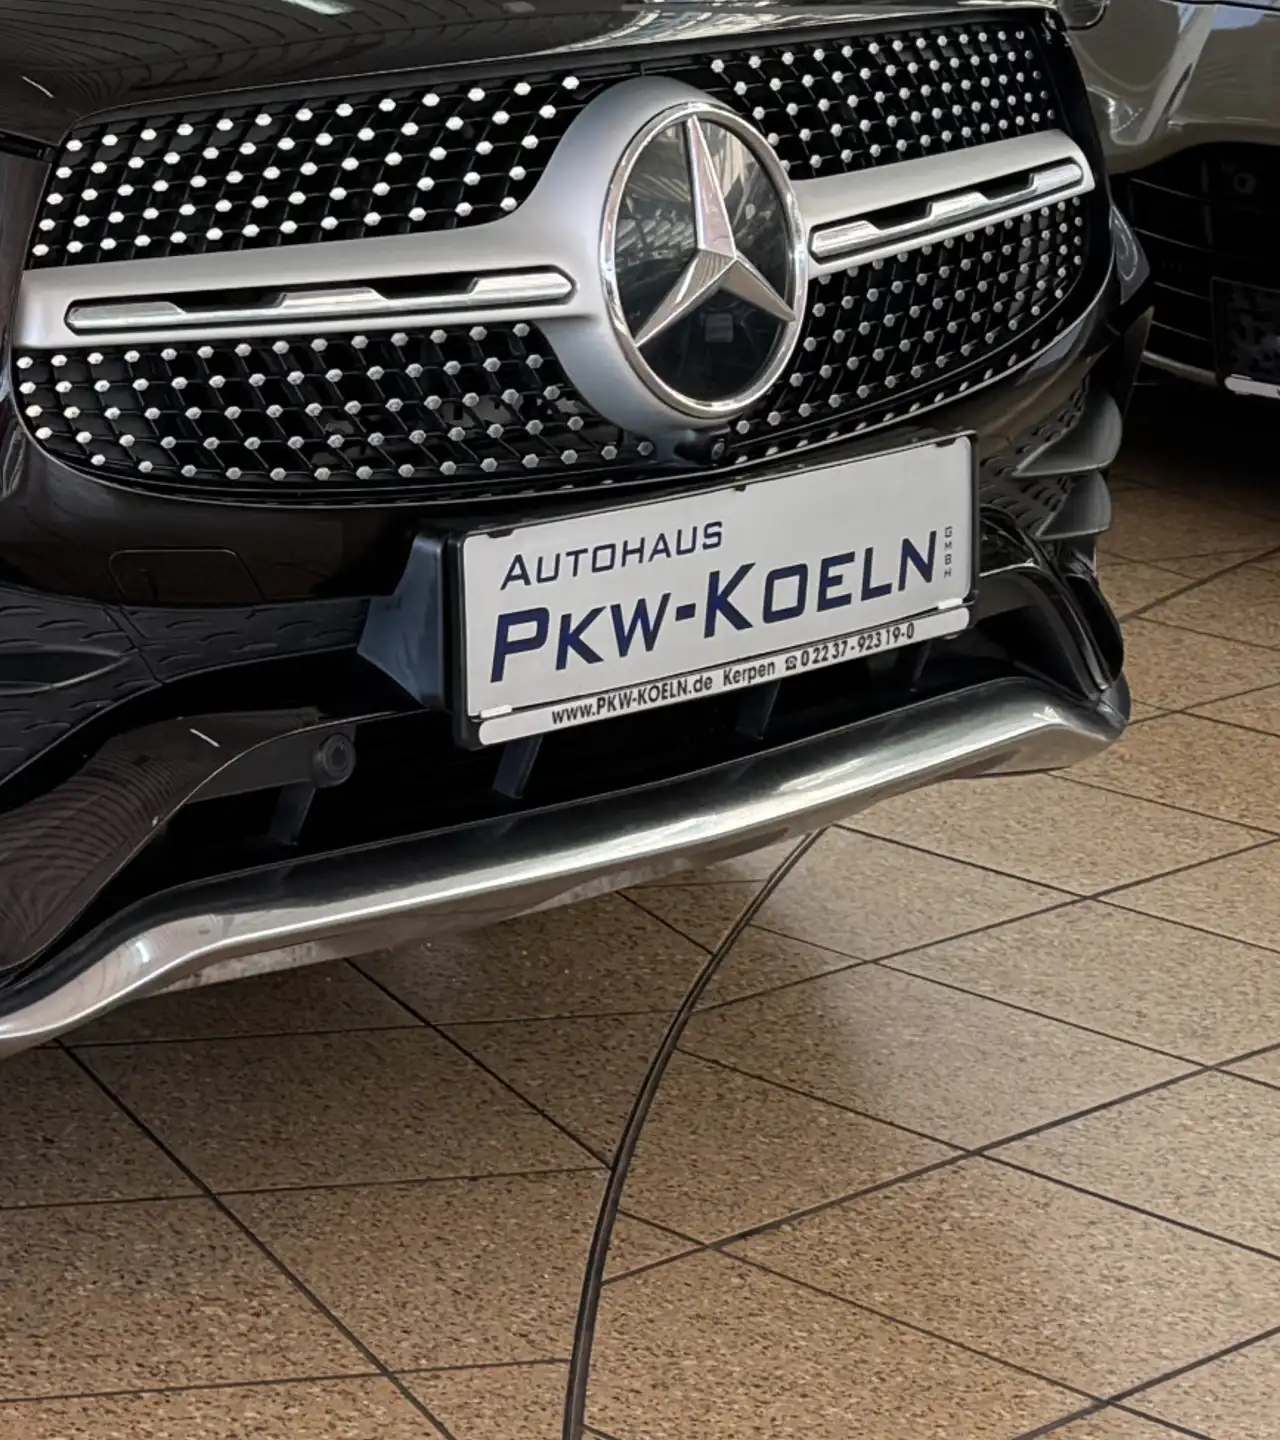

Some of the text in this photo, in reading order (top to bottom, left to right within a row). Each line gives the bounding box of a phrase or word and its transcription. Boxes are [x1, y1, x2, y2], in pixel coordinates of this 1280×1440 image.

[500, 520, 724, 591] AUTOHAUS
[489, 529, 938, 685] PKW-KOELN
[550, 675, 714, 725] www.PKW-KOELN.de
[722, 658, 776, 687] Kerpen
